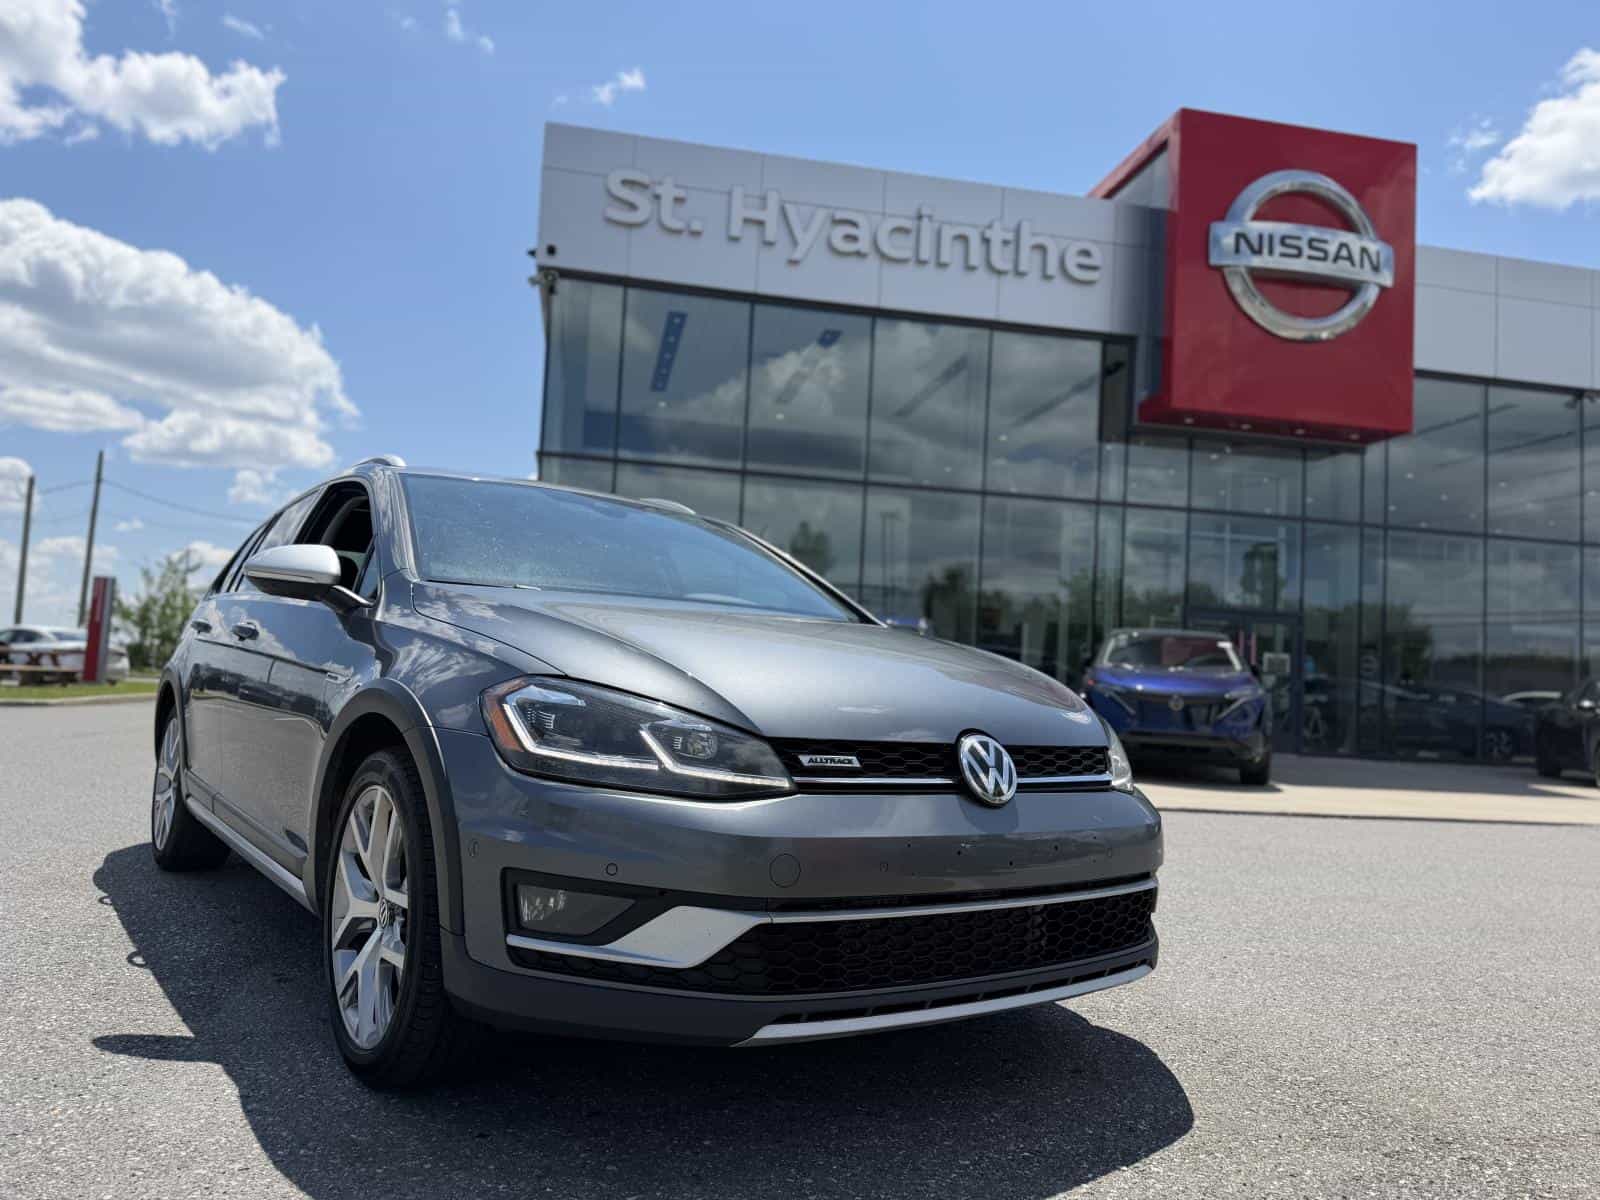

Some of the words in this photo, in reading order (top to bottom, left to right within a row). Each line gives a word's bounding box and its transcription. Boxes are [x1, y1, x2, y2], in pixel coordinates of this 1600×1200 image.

[603, 169, 703, 236] St.
[728, 184, 1103, 284] Hyacinthe
[1233, 231, 1381, 273] NISSAN
[807, 756, 855, 765] ALLTRACK
